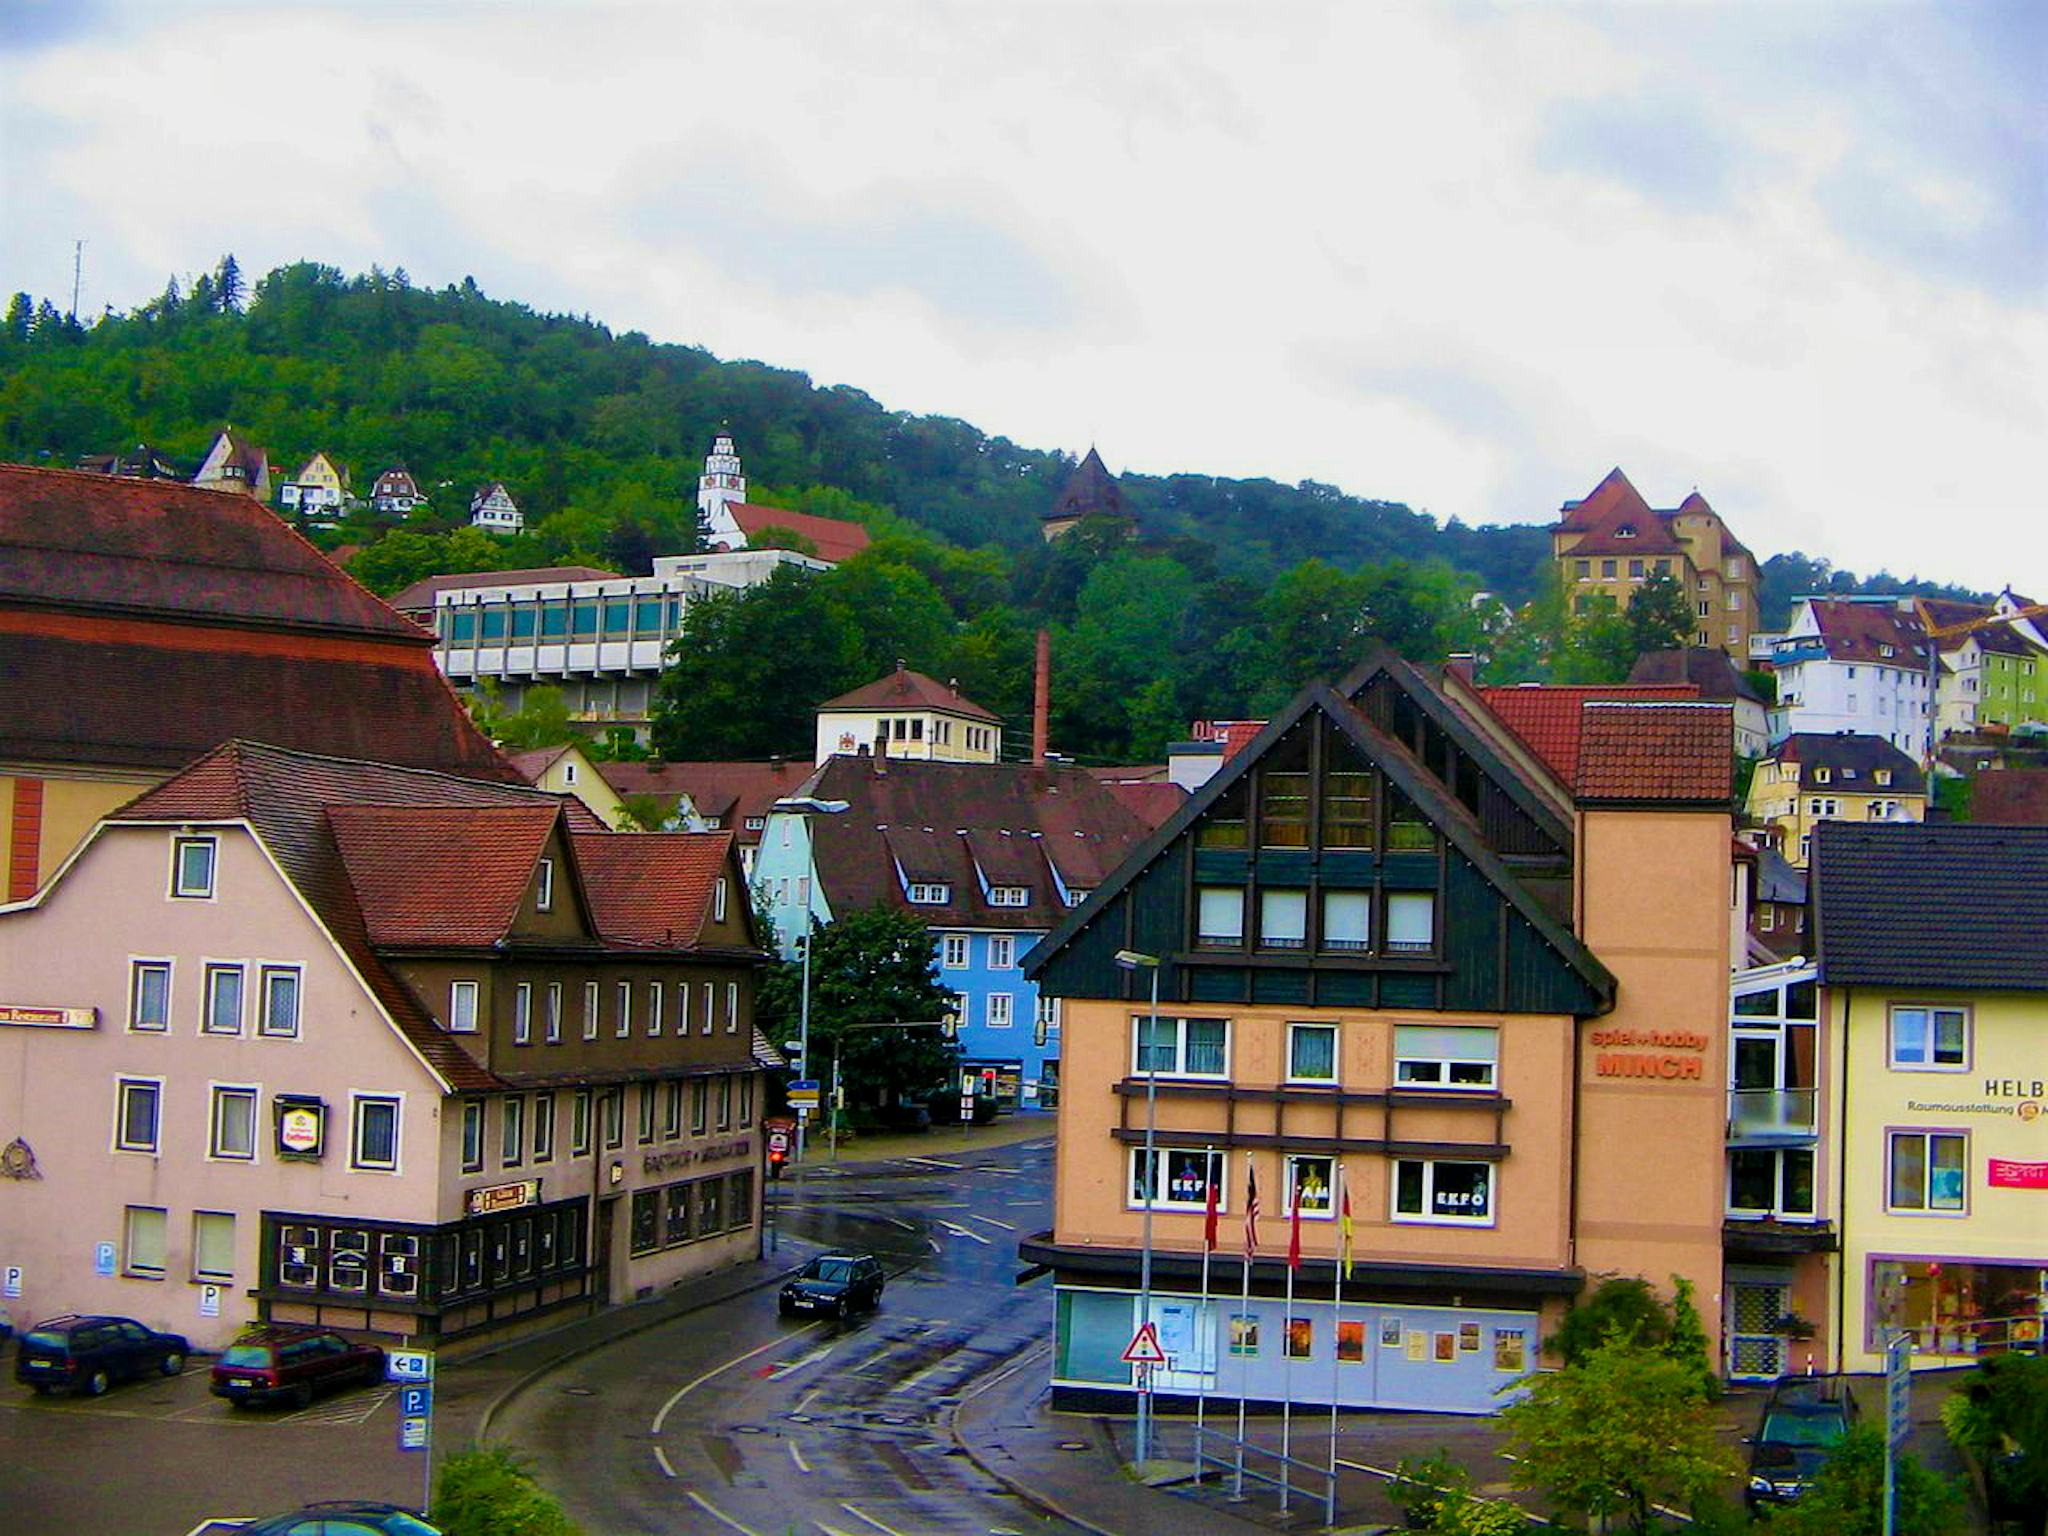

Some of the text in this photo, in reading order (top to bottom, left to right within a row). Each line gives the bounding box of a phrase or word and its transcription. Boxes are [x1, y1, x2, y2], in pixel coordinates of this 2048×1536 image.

[1597, 1053, 1702, 1079] MINCH
[1436, 1191, 1485, 1207] EKFO
[100, 1245, 113, 1263] P
[8, 1268, 20, 1285] P
[204, 1286, 217, 1304] P
[407, 1391, 421, 1412] P
